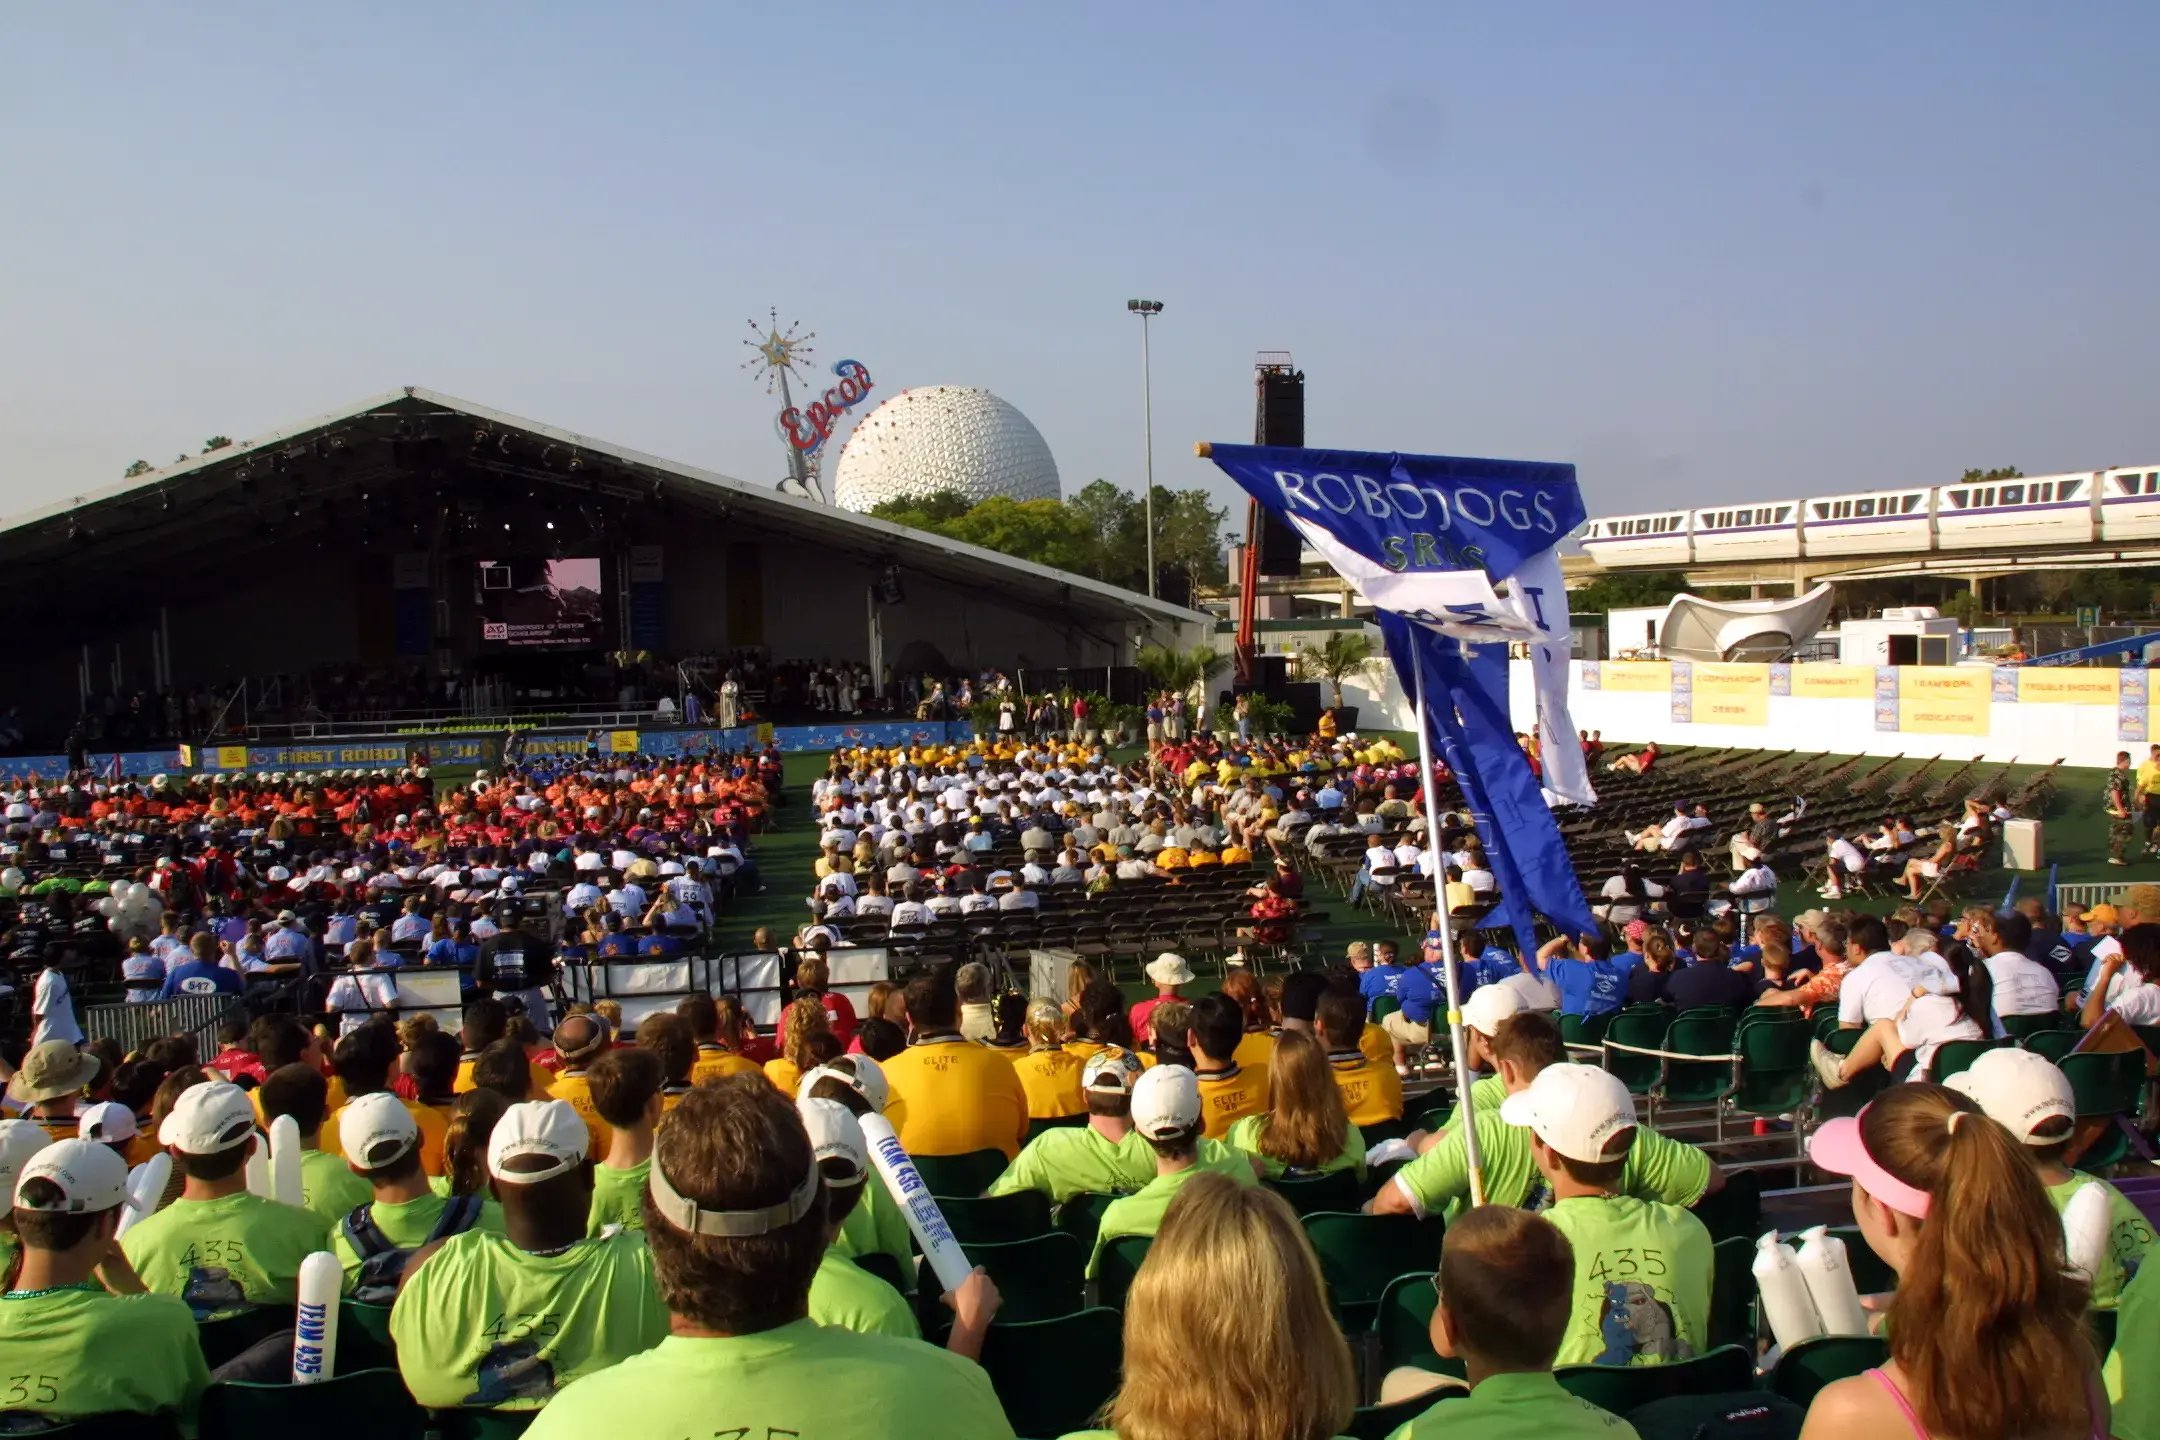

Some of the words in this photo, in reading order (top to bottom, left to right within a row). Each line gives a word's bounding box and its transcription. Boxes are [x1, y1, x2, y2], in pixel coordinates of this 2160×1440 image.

[780, 359, 875, 450] Epcot
[1382, 532, 1486, 573] SRS
[1804, 678, 1861, 686] COMMUNITY
[1914, 680, 1974, 689] TEAMWORK
[279, 749, 335, 764] FIRST
[187, 981, 210, 991] 547
[923, 1055, 960, 1065] ELITE
[1213, 1090, 1247, 1106] ELITE
[876, 1136, 912, 1168] TEAM
[895, 1167, 925, 1194] 435
[179, 1240, 244, 1266] 435
[1588, 1248, 1667, 1281] 435
[298, 1302, 327, 1341] TEAM
[482, 1313, 561, 1340] 435
[296, 1344, 323, 1375] 435
[0, 1374, 60, 1404] 35
